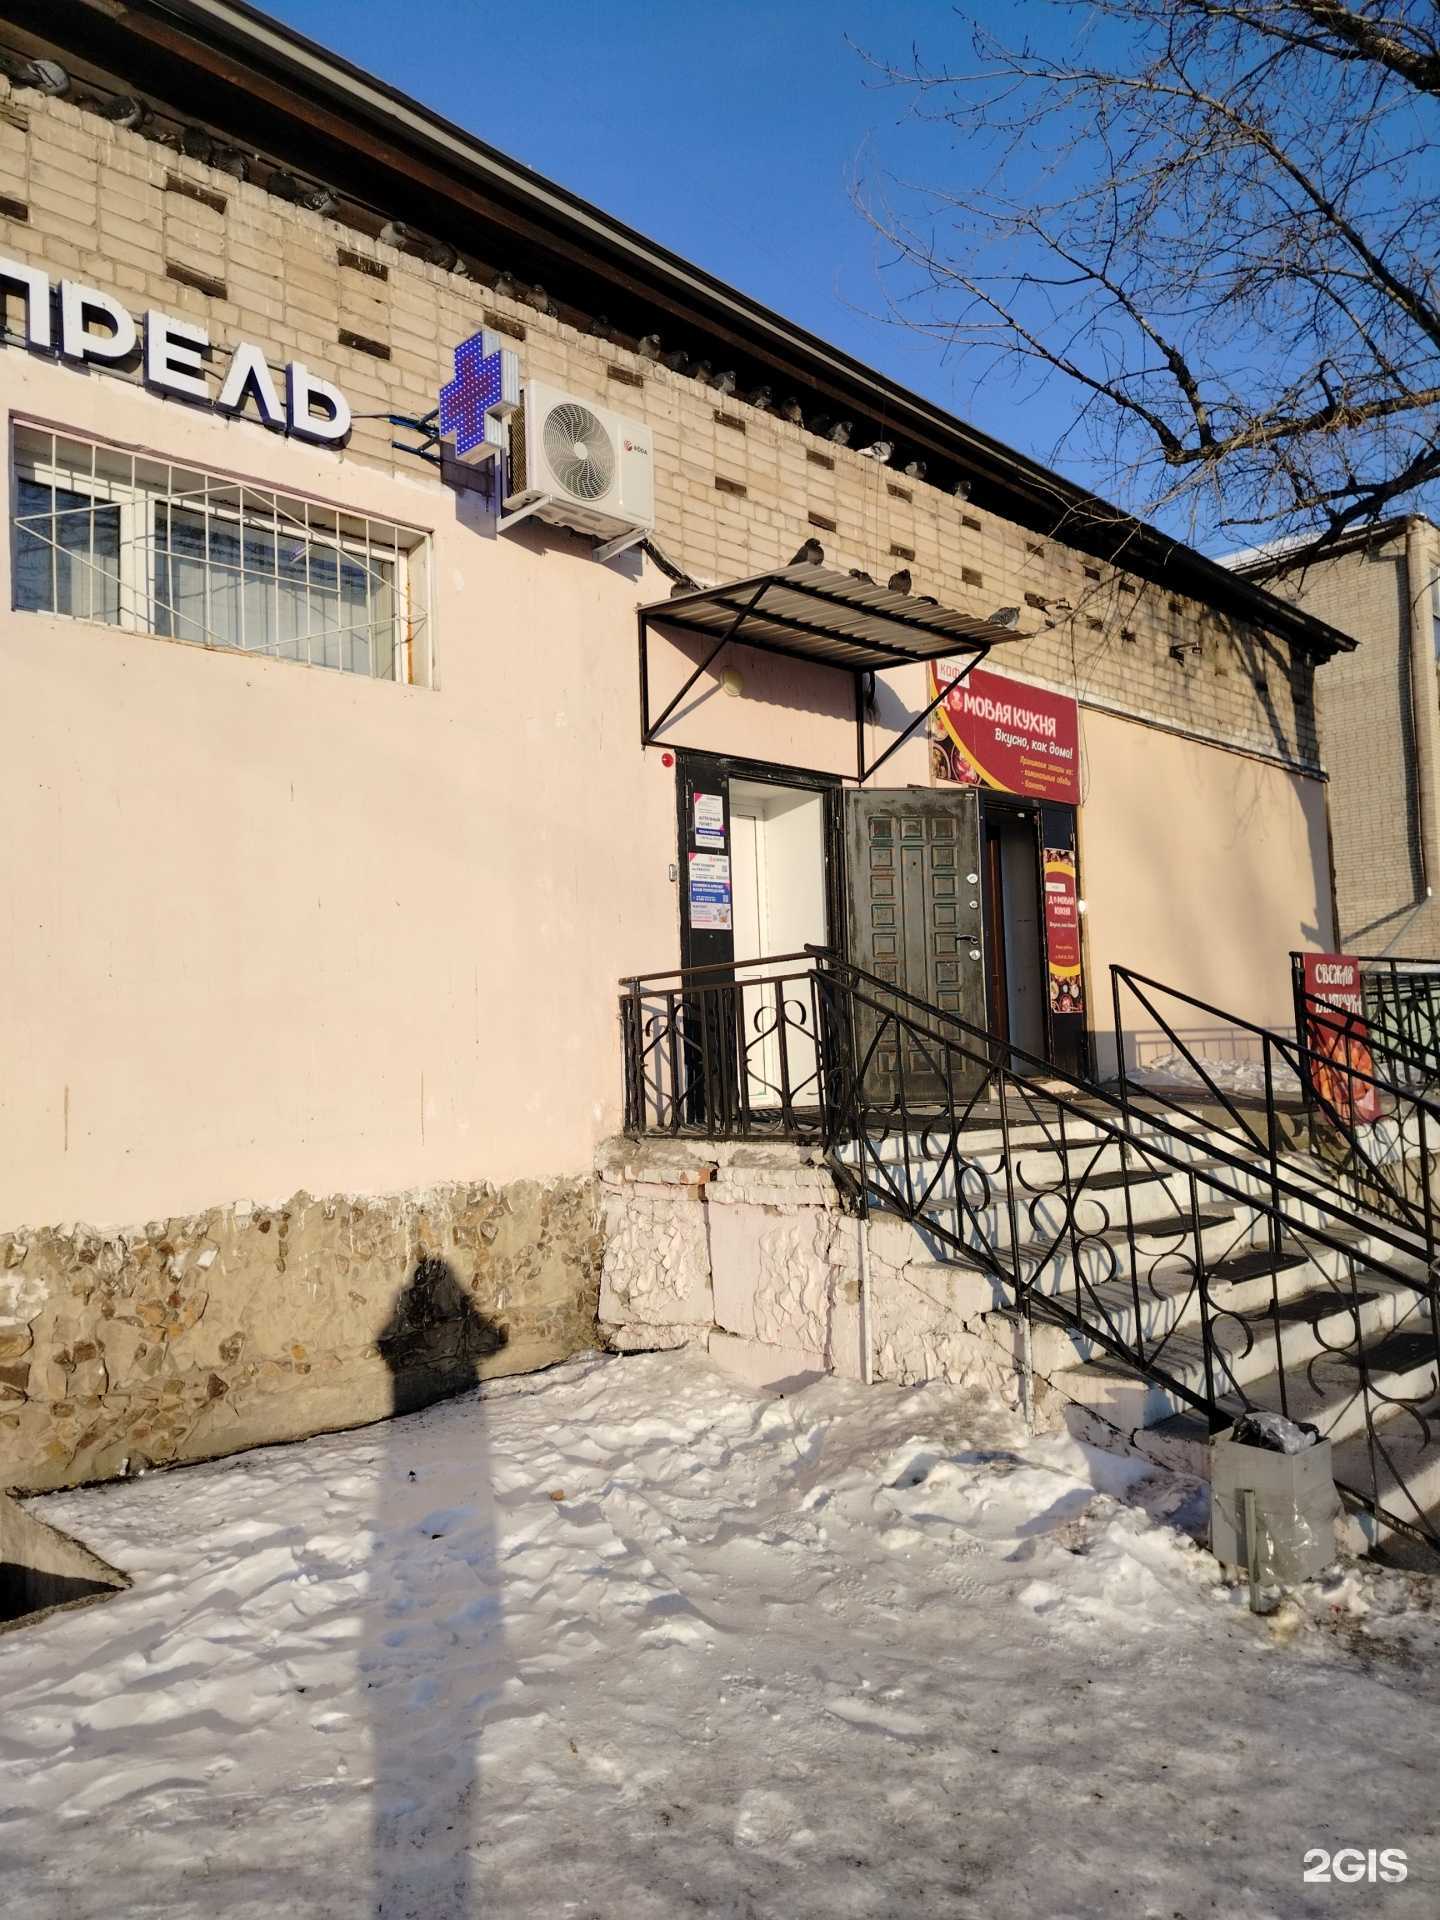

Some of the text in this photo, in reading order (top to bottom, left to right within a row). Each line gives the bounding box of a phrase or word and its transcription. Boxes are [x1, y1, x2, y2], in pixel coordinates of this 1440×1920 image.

[1013, 708, 1057, 738] КУХНЯ
[994, 727, 1073, 760] Вкусно, как дома!
[1315, 962, 1354, 987] СВЕЖАЯ
